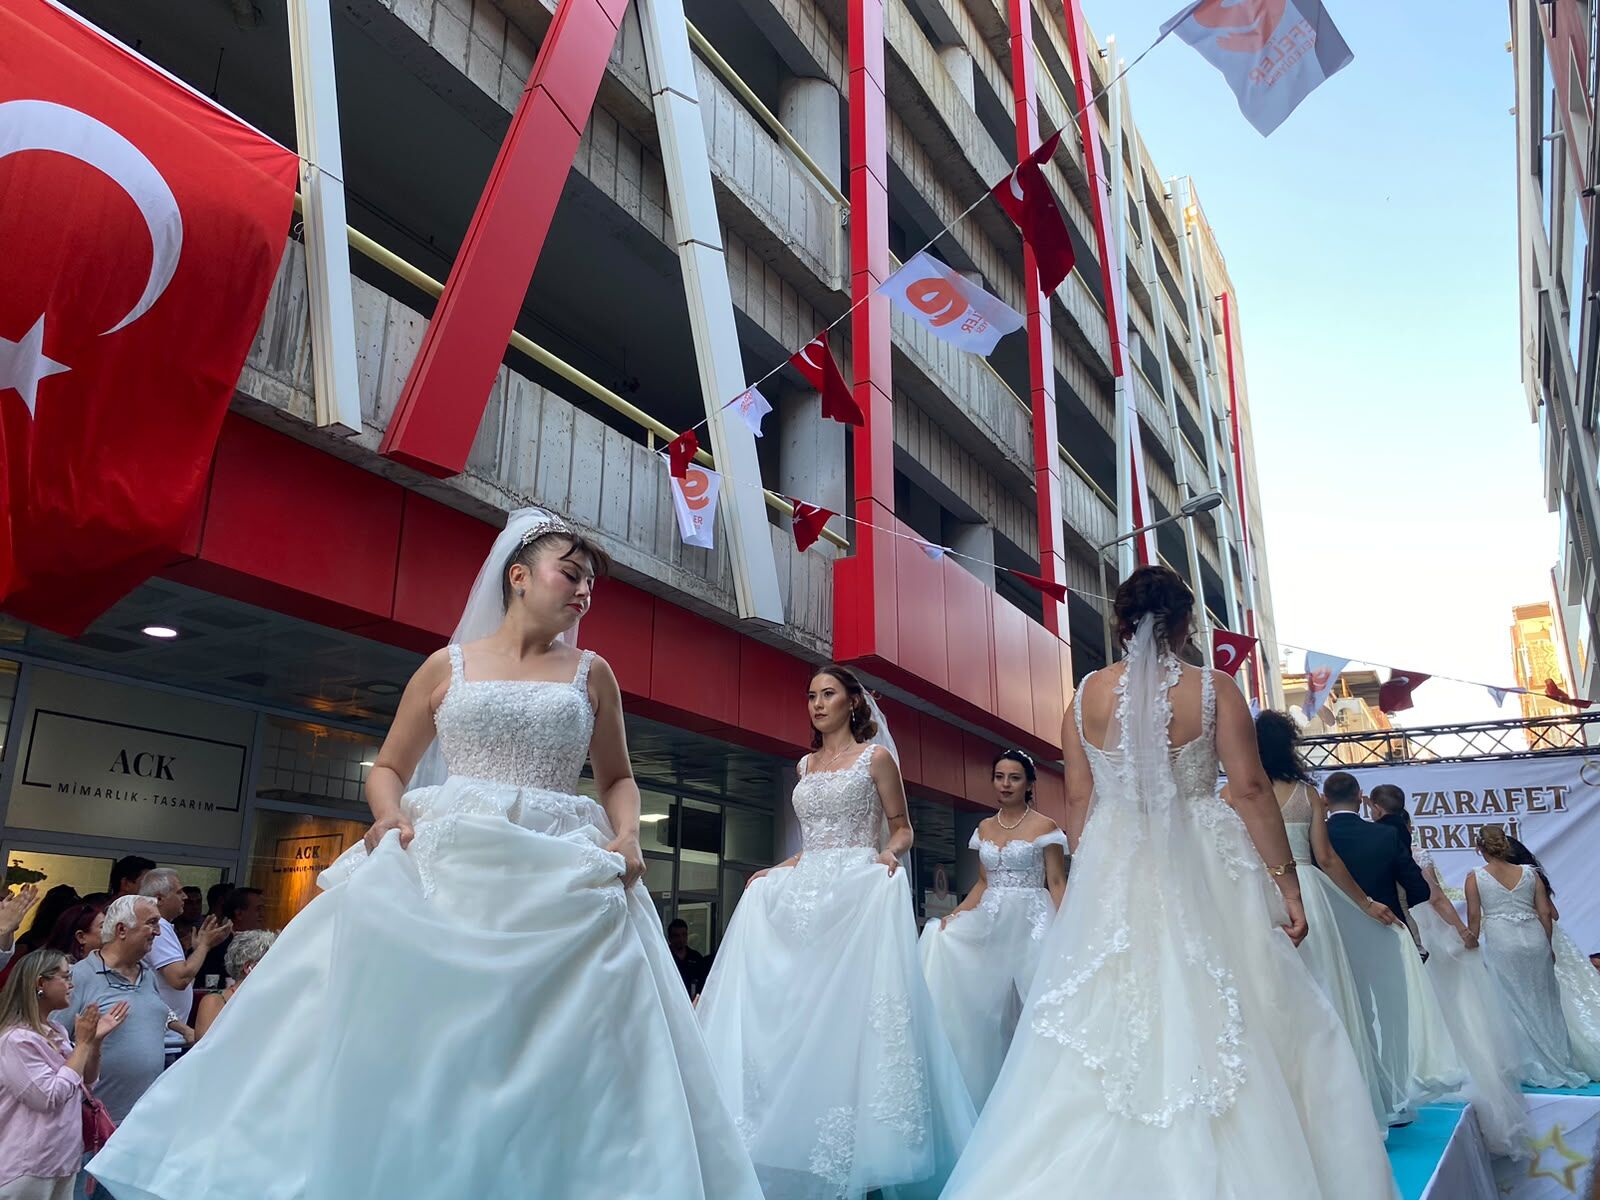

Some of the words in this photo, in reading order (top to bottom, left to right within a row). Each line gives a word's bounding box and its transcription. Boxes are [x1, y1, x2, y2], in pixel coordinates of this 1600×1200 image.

[109, 749, 176, 781] ACK
[57, 781, 139, 802] MİMARLIK
[153, 794, 214, 812] TASARIM
[1411, 785, 1569, 816] ZARAFET
[295, 845, 321, 859] ACK
